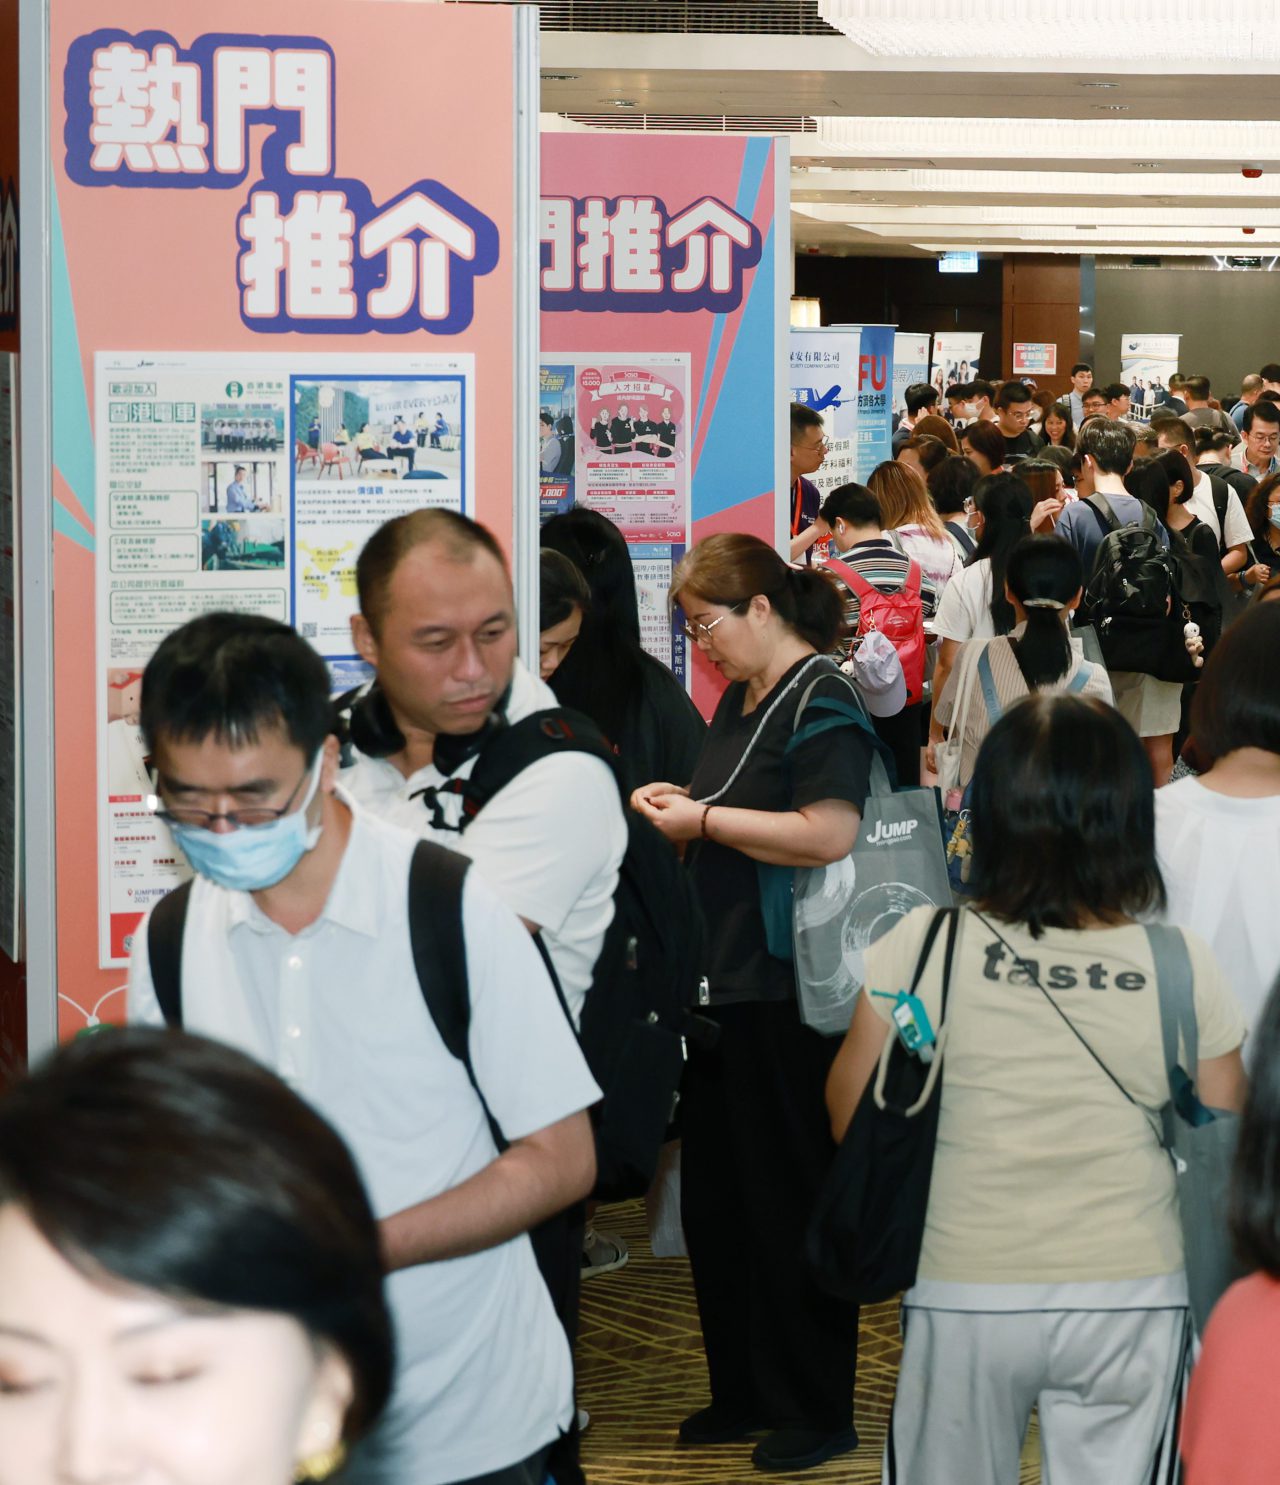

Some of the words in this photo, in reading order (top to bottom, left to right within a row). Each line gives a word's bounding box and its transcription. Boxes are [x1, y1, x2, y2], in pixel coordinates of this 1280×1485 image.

[90, 43, 331, 173] 熱門
[239, 190, 476, 319] 推介
[614, 383, 650, 392] 人才招募
[857, 354, 887, 391] FU
[866, 819, 918, 843] JUMP
[983, 941, 1146, 991] taste
